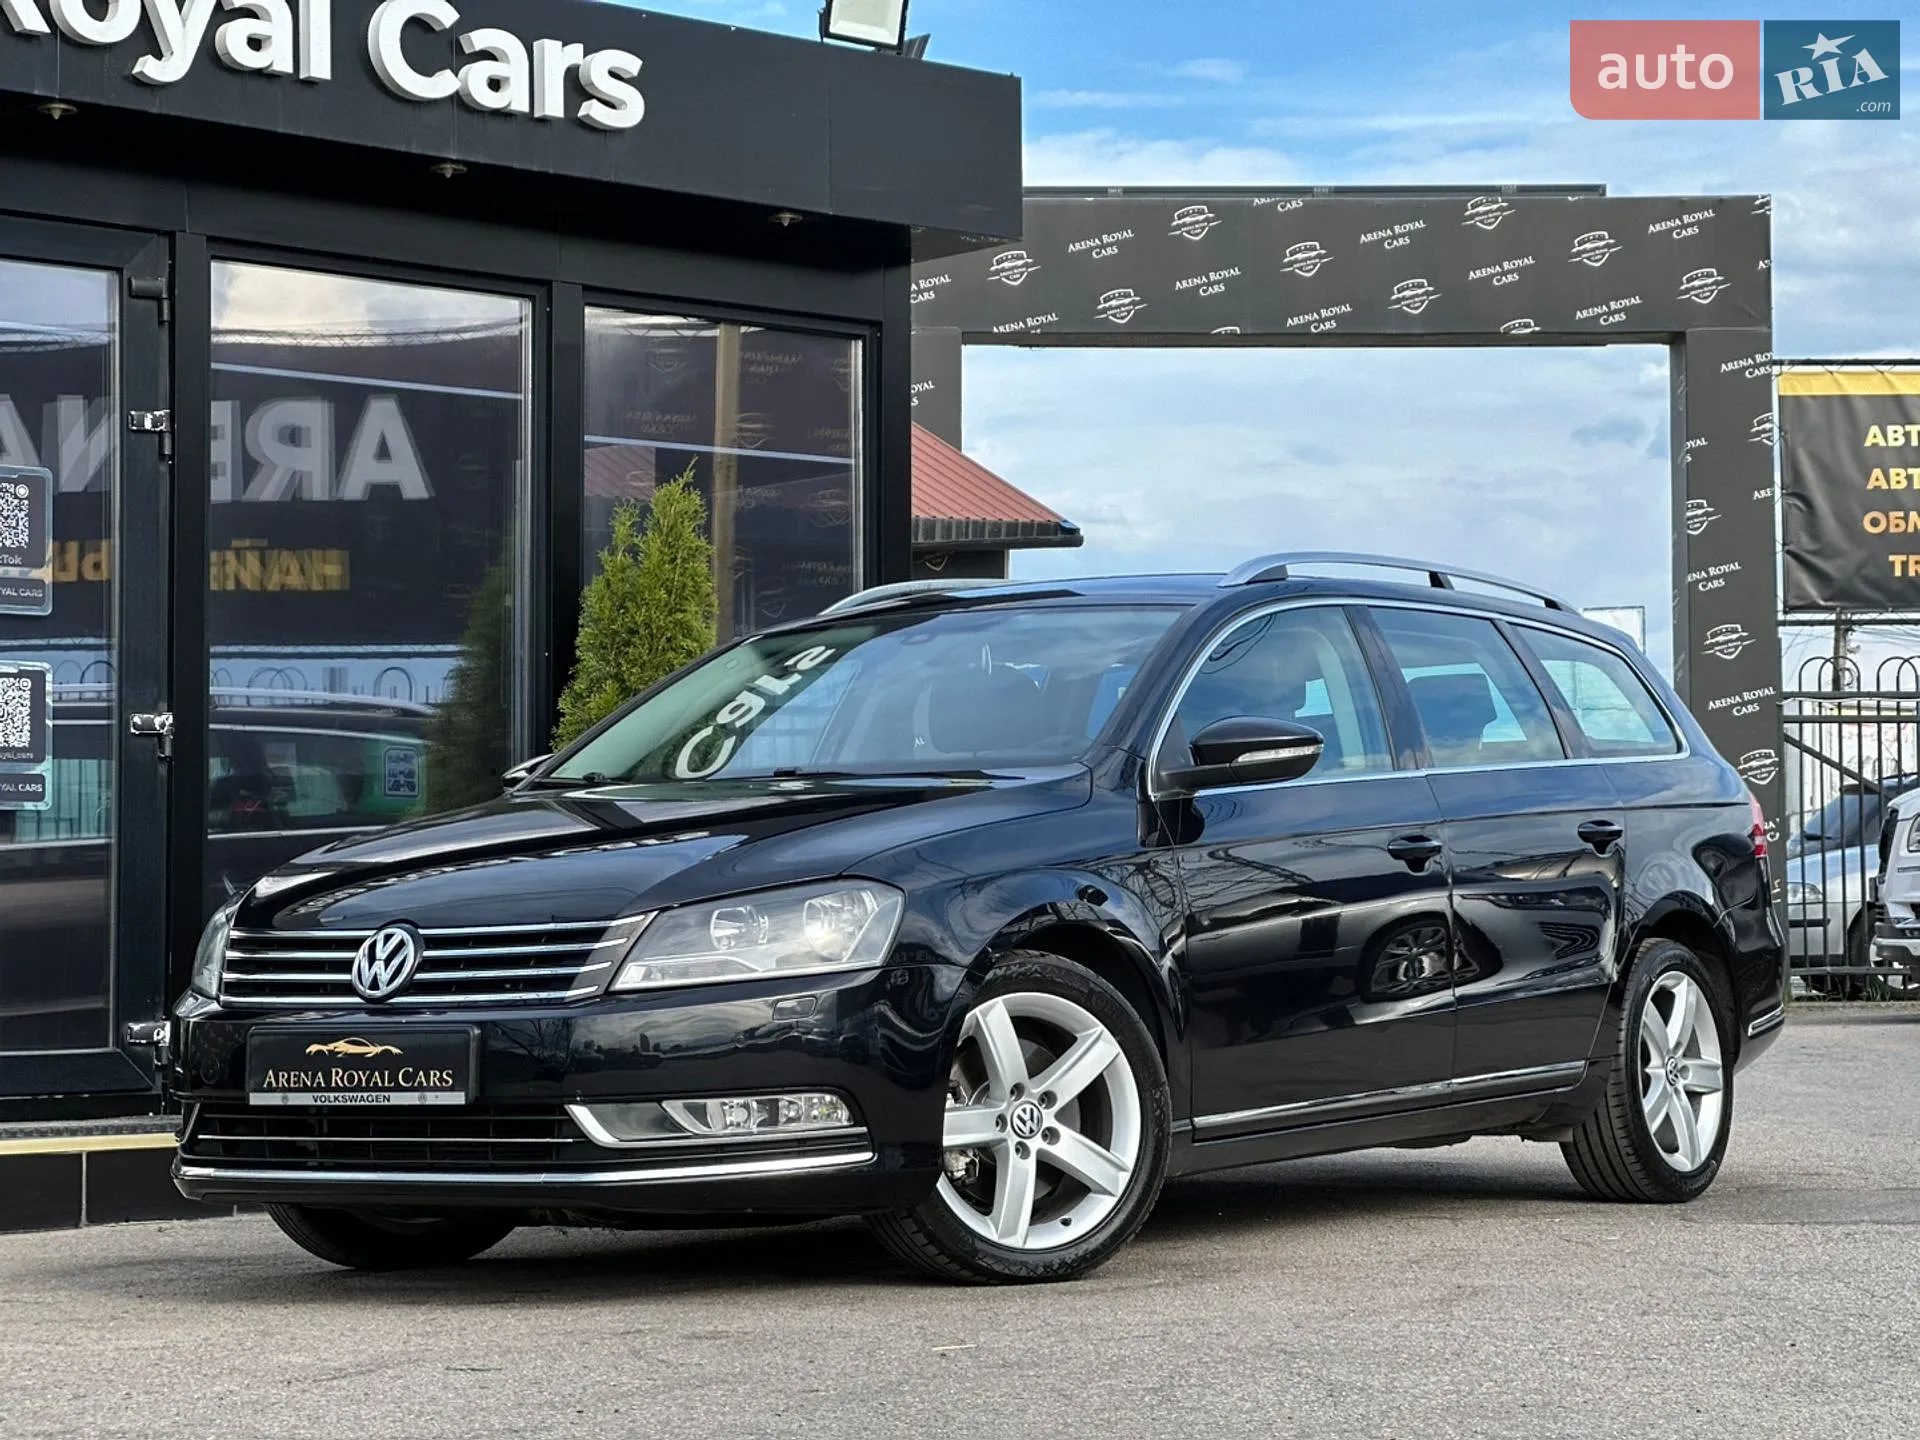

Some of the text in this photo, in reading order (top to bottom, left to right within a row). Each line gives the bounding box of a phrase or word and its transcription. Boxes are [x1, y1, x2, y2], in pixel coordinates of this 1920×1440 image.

[0, 0, 646, 131] oyal Cars
[1648, 208, 1717, 235] ARENA ROYAL
[1360, 219, 1427, 244] ARENA ROYAL
[1672, 225, 1700, 240] CARS
[1067, 228, 1135, 254] ARENA ROYAL
[1384, 234, 1411, 250] CARS
[1092, 245, 1118, 260] CARS
[1468, 255, 1536, 281] ARENA ROYAL
[1175, 266, 1242, 292] ARENA ROYAL
[1493, 272, 1520, 287] CARS
[1199, 282, 1226, 298] CARS
[1286, 303, 1353, 328] ARENA ROYAL
[1575, 295, 1643, 321] ARENA ROYAL
[1026, 312, 1059, 328] ROYAL
[1310, 319, 1337, 334] CARS
[1600, 311, 1627, 326] CARS
[1720, 357, 1754, 373] ARENA
[1708, 561, 1742, 576] ROYAL
[1698, 578, 1726, 591] CARS
[1708, 687, 1776, 711] ARENA ROYAL
[1733, 703, 1760, 717] CARS
[263, 1067, 453, 1088] ARENA ROYAL CARS
[312, 1094, 391, 1104] VOLKSWAGEN
